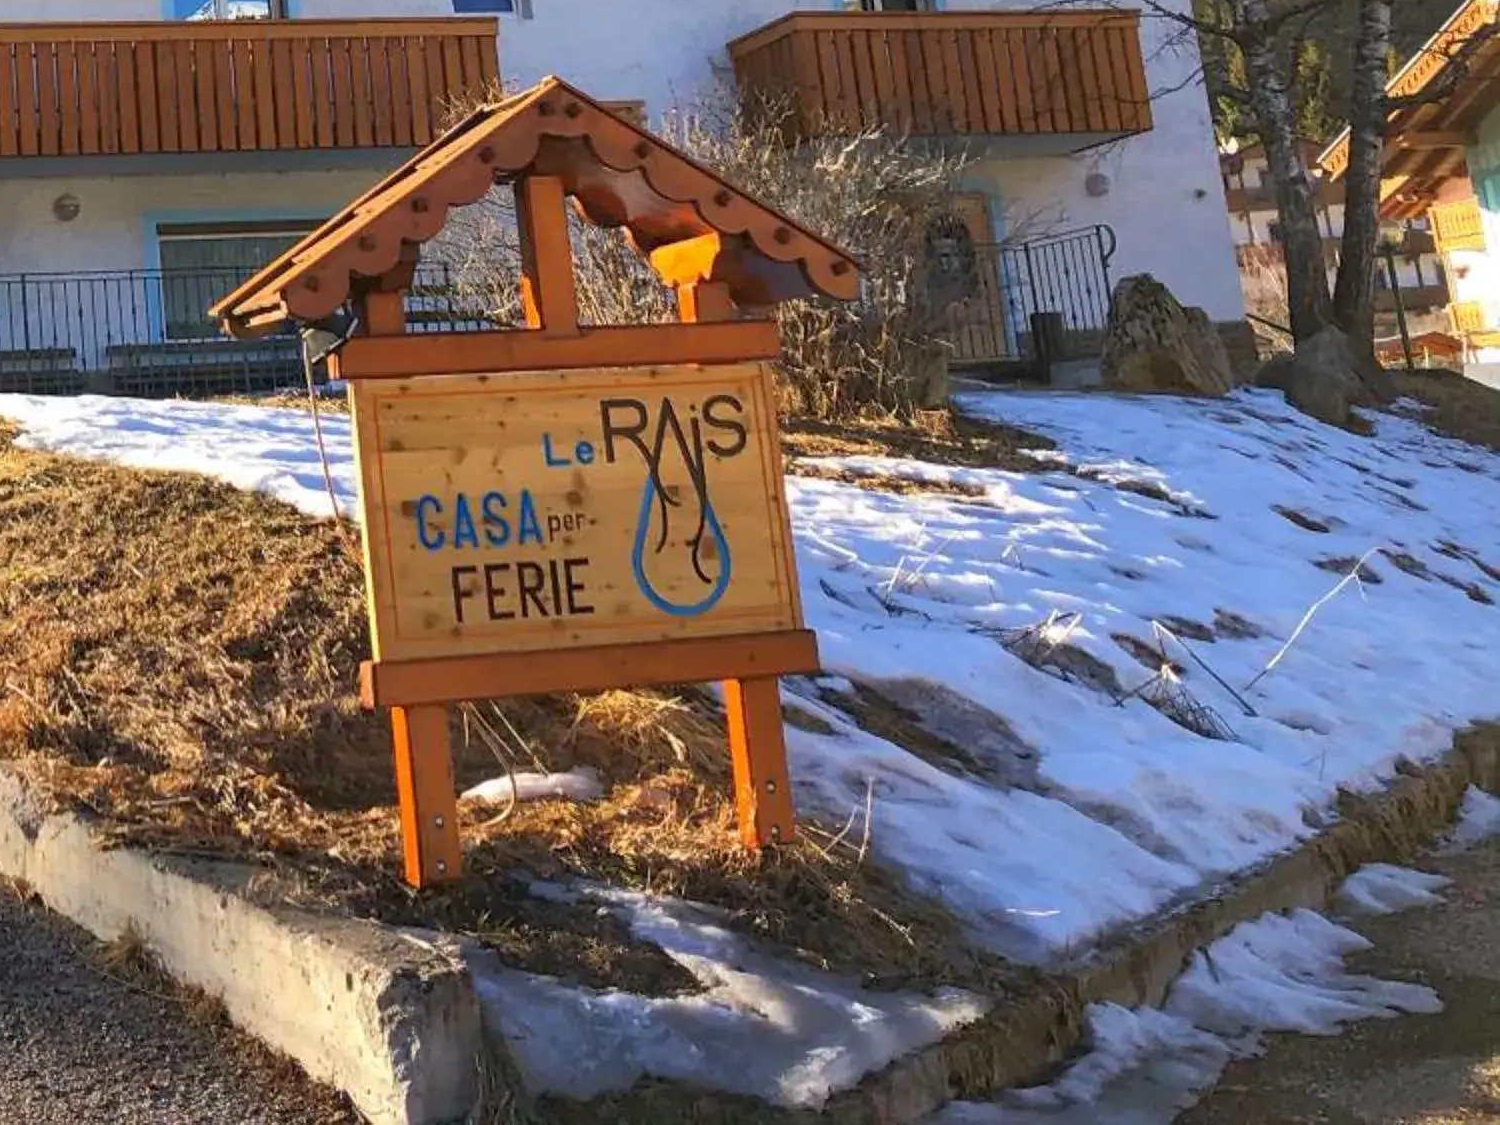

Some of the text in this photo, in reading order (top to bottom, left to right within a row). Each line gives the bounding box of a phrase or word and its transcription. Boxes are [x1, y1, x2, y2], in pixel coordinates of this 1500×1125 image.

[541, 433, 595, 467] Le
[415, 488, 586, 551] CASA per
[451, 558, 595, 623] FERIE
